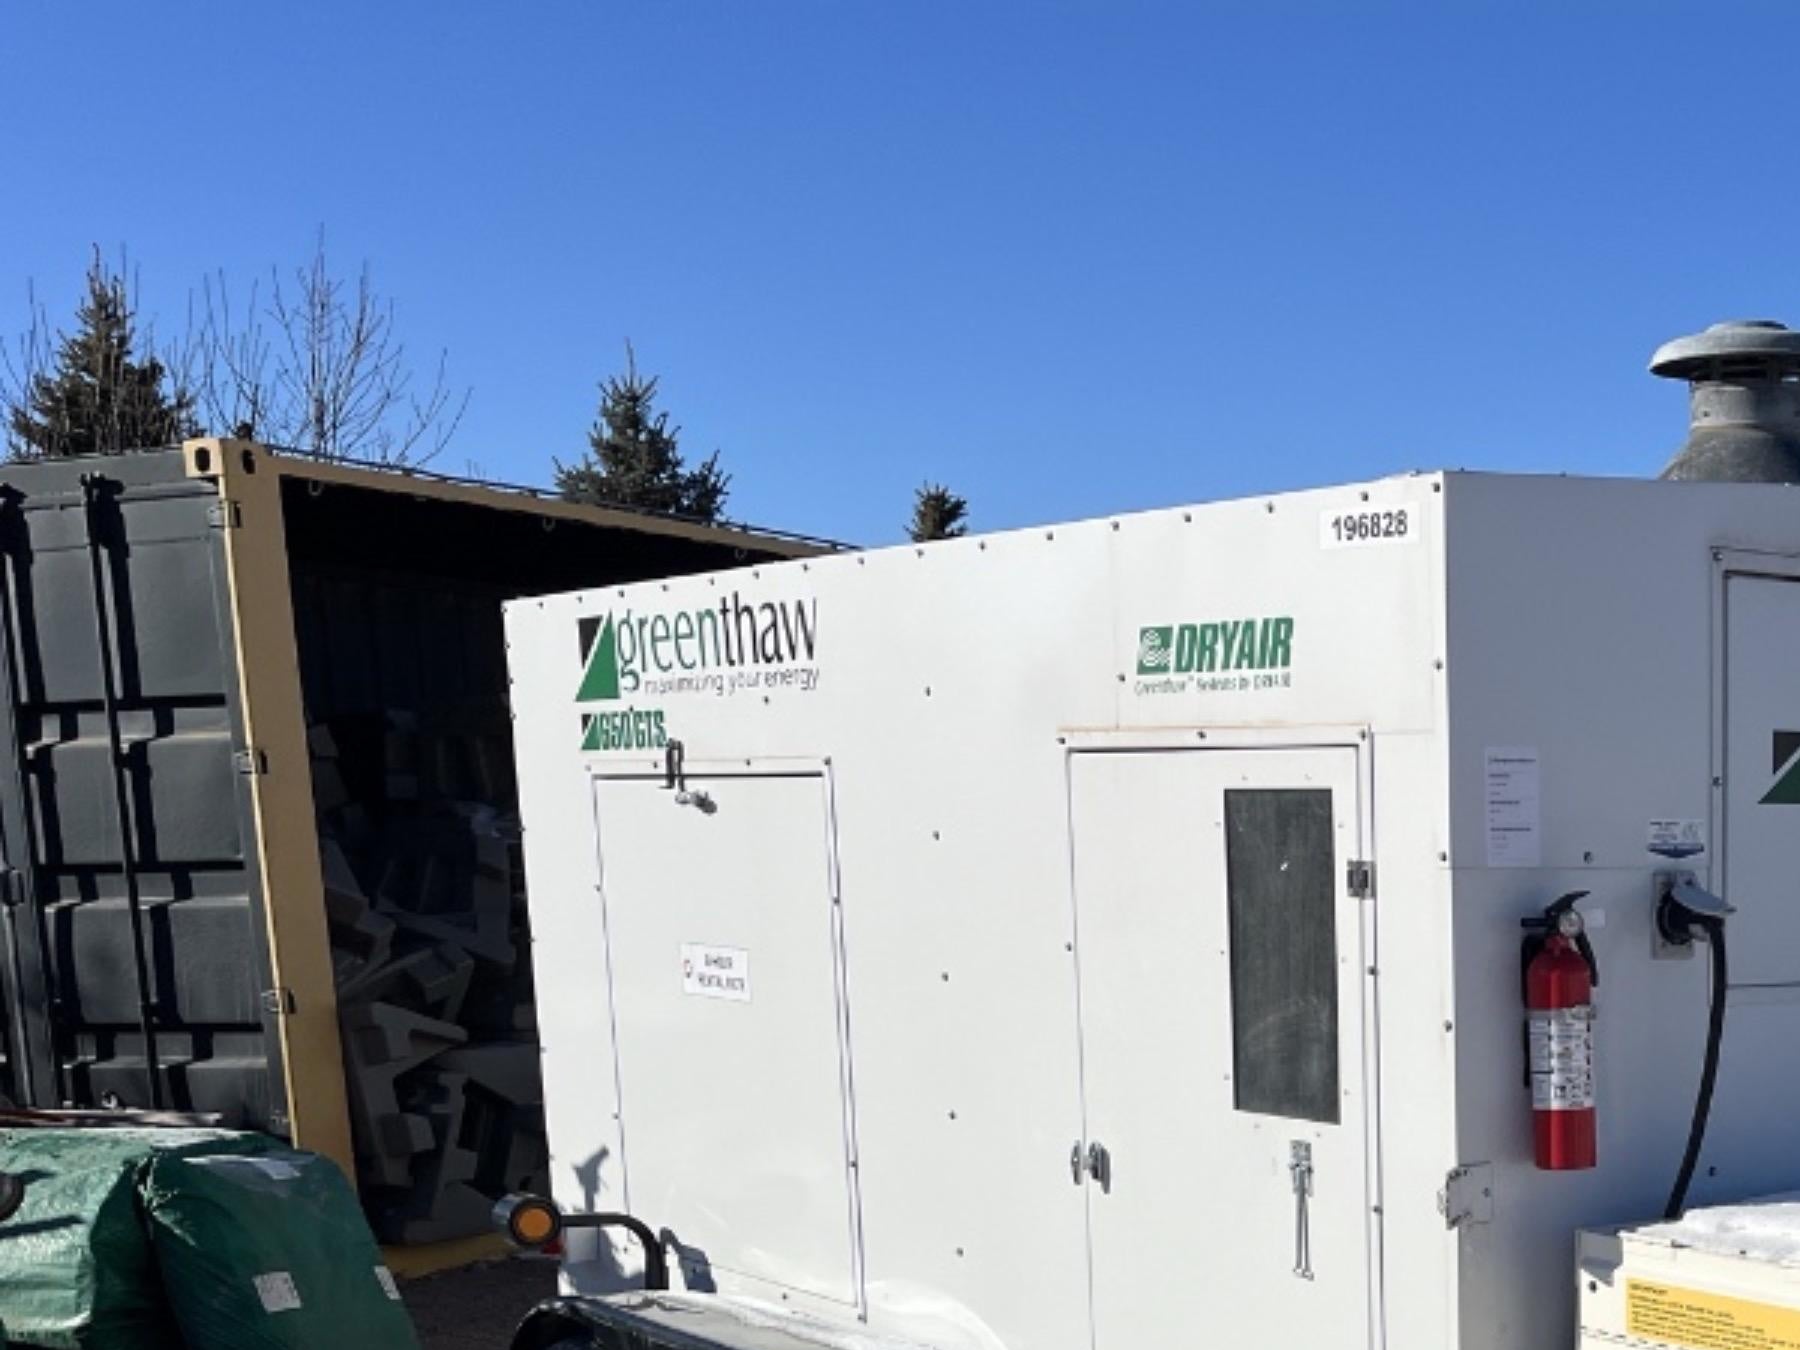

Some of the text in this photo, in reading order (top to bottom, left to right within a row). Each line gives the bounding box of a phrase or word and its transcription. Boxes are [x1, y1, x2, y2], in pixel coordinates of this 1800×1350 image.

[1332, 509, 1408, 541] 196828
[616, 591, 818, 692] greenthaw
[1174, 616, 1294, 673] DRYAIR
